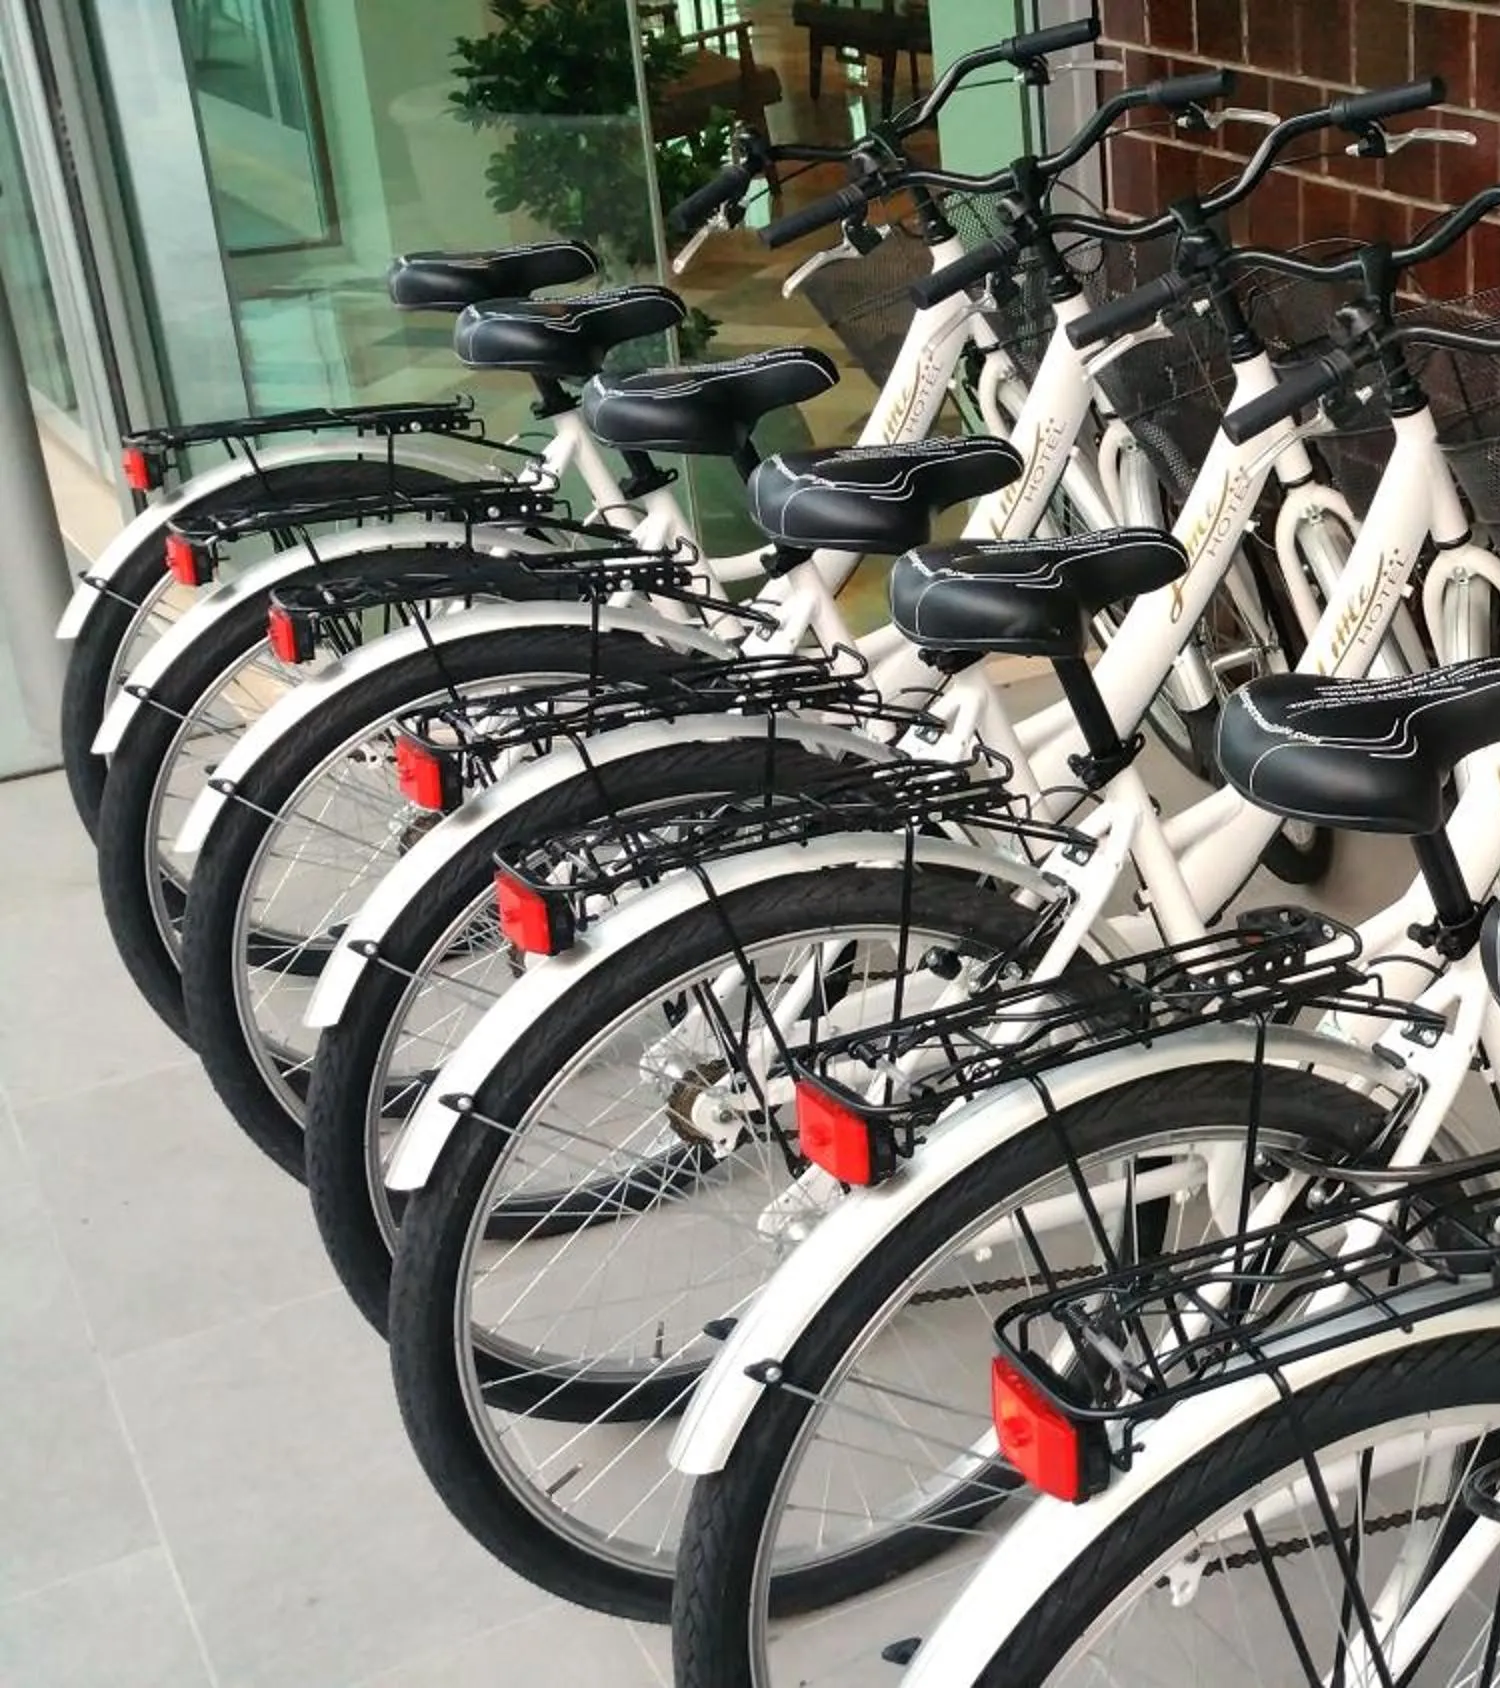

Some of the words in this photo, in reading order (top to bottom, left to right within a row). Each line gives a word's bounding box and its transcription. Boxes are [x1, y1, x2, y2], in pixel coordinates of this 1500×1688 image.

[905, 362, 944, 434] HOTEL
[1023, 423, 1066, 503] HOTEL
[1357, 558, 1406, 646] HOTEL
